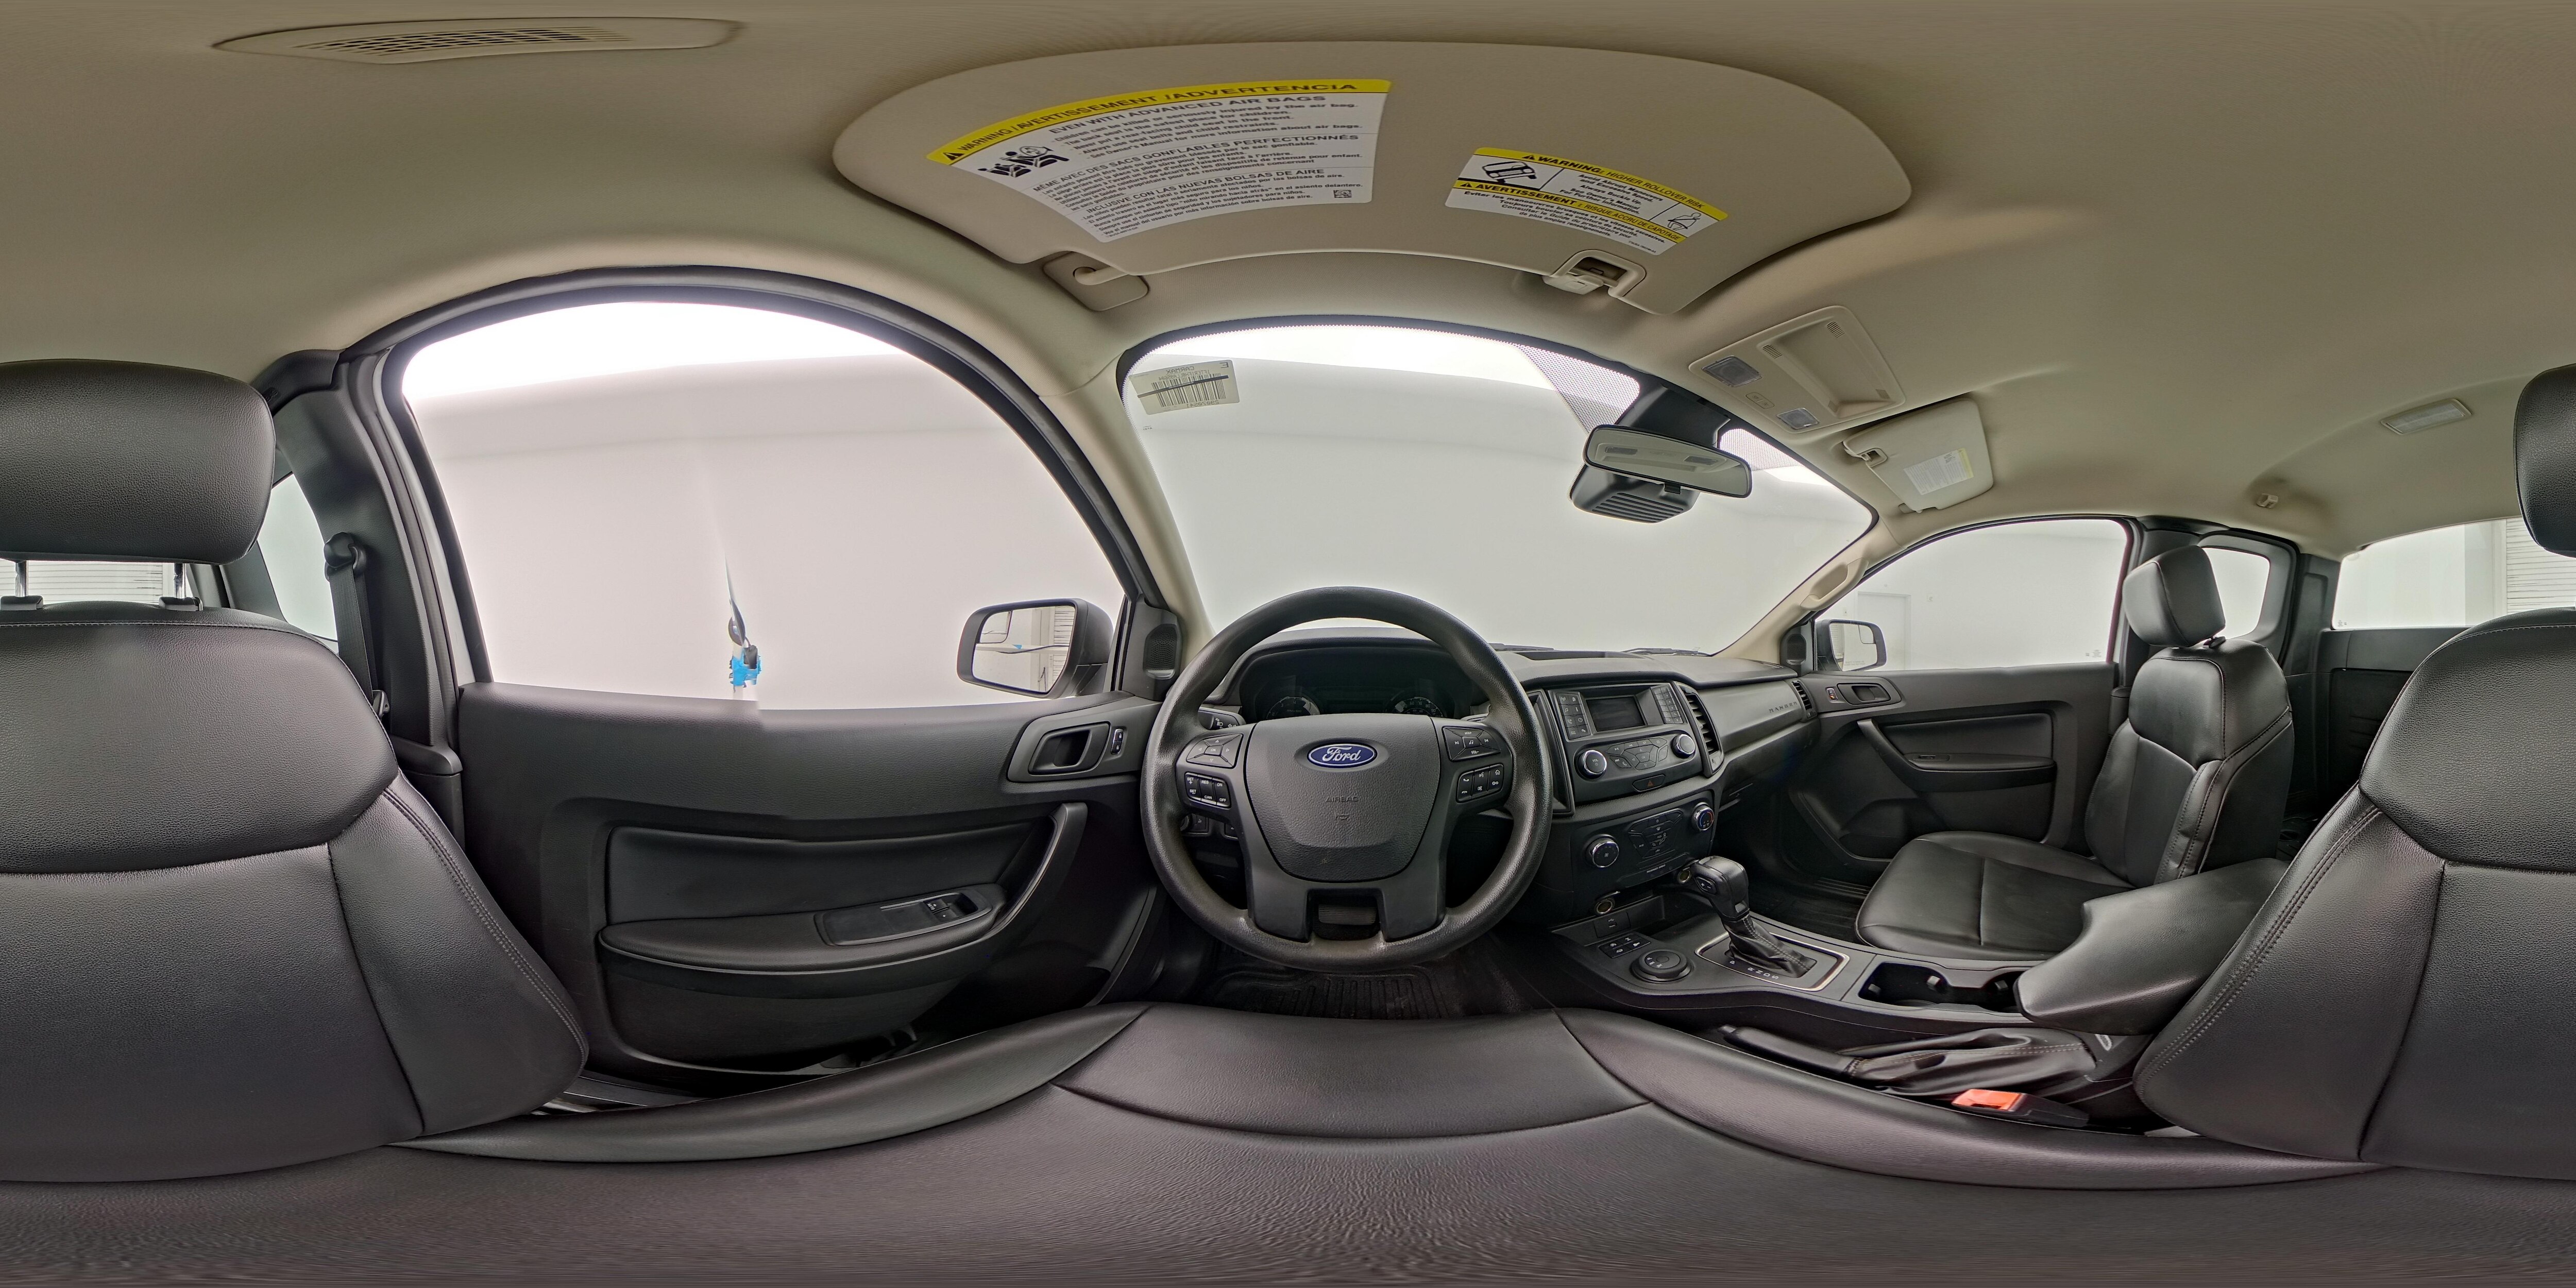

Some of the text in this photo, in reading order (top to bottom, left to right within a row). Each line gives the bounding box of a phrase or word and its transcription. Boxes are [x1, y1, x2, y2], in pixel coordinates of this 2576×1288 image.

[958, 85, 1356, 150] WARNING /AVERTISSEMENT /ADVERTENCIA
[1049, 123, 1087, 133] EVEN
[1086, 114, 1125, 124] WITH
[1129, 102, 1223, 116] ADVANCED
[1055, 131, 1090, 141] Children
[1121, 128, 1173, 138] rear-facing
[1106, 145, 1139, 154] Owner's
[1140, 139, 1173, 147] Manual
[1033, 135, 1358, 191] MÊME AVEC DES SACS GONFLABLES PERFECTIONNÉS
[1065, 197, 1093, 208] Consultez
[1127, 178, 1166, 189] propriétaire
[1202, 163, 1264, 173] renseignements
[1086, 197, 1132, 213] INCLUSIVE
[1178, 178, 1222, 189] NUEVAS
[1225, 173, 1273, 181] BOLSAS
[1538, 157, 1705, 208] WARNING: HIGHER ROLLOVER RISK
[1580, 185, 1606, 193] Always
[1607, 192, 1631, 200] Buckle
[1596, 182, 1631, 194] Excessive
[1632, 193, 1653, 202] Speed.
[1600, 180, 1627, 189] Abrupt
[1628, 188, 1663, 201] Maneuvers
[1476, 184, 1577, 204] AVERTISSEMENT
[1584, 205, 1614, 215] RISQUE
[1612, 213, 1638, 223] ACCRU
[1647, 225, 1681, 240] CAPOTAGE
[1573, 193, 1601, 201] Further
[1602, 200, 1639, 214] Information.
[1586, 192, 1615, 201] Owner's
[1616, 200, 1640, 210] Manual
[1500, 200, 1533, 208] Toujours
[1575, 216, 1602, 225] ceinture
[1613, 227, 1637, 236] sécurité.
[1502, 205, 1539, 213] Consulter
[1581, 222, 1619, 234] propriétaire
[1507, 198, 1554, 208] manoeuvres
[1556, 207, 1589, 216] brusques
[1610, 221, 1634, 230] vitesses
[1635, 230, 1665, 243] excessives.
[1567, 223, 1611, 236] renseignements.
[1323, 747, 1362, 761] Ford
